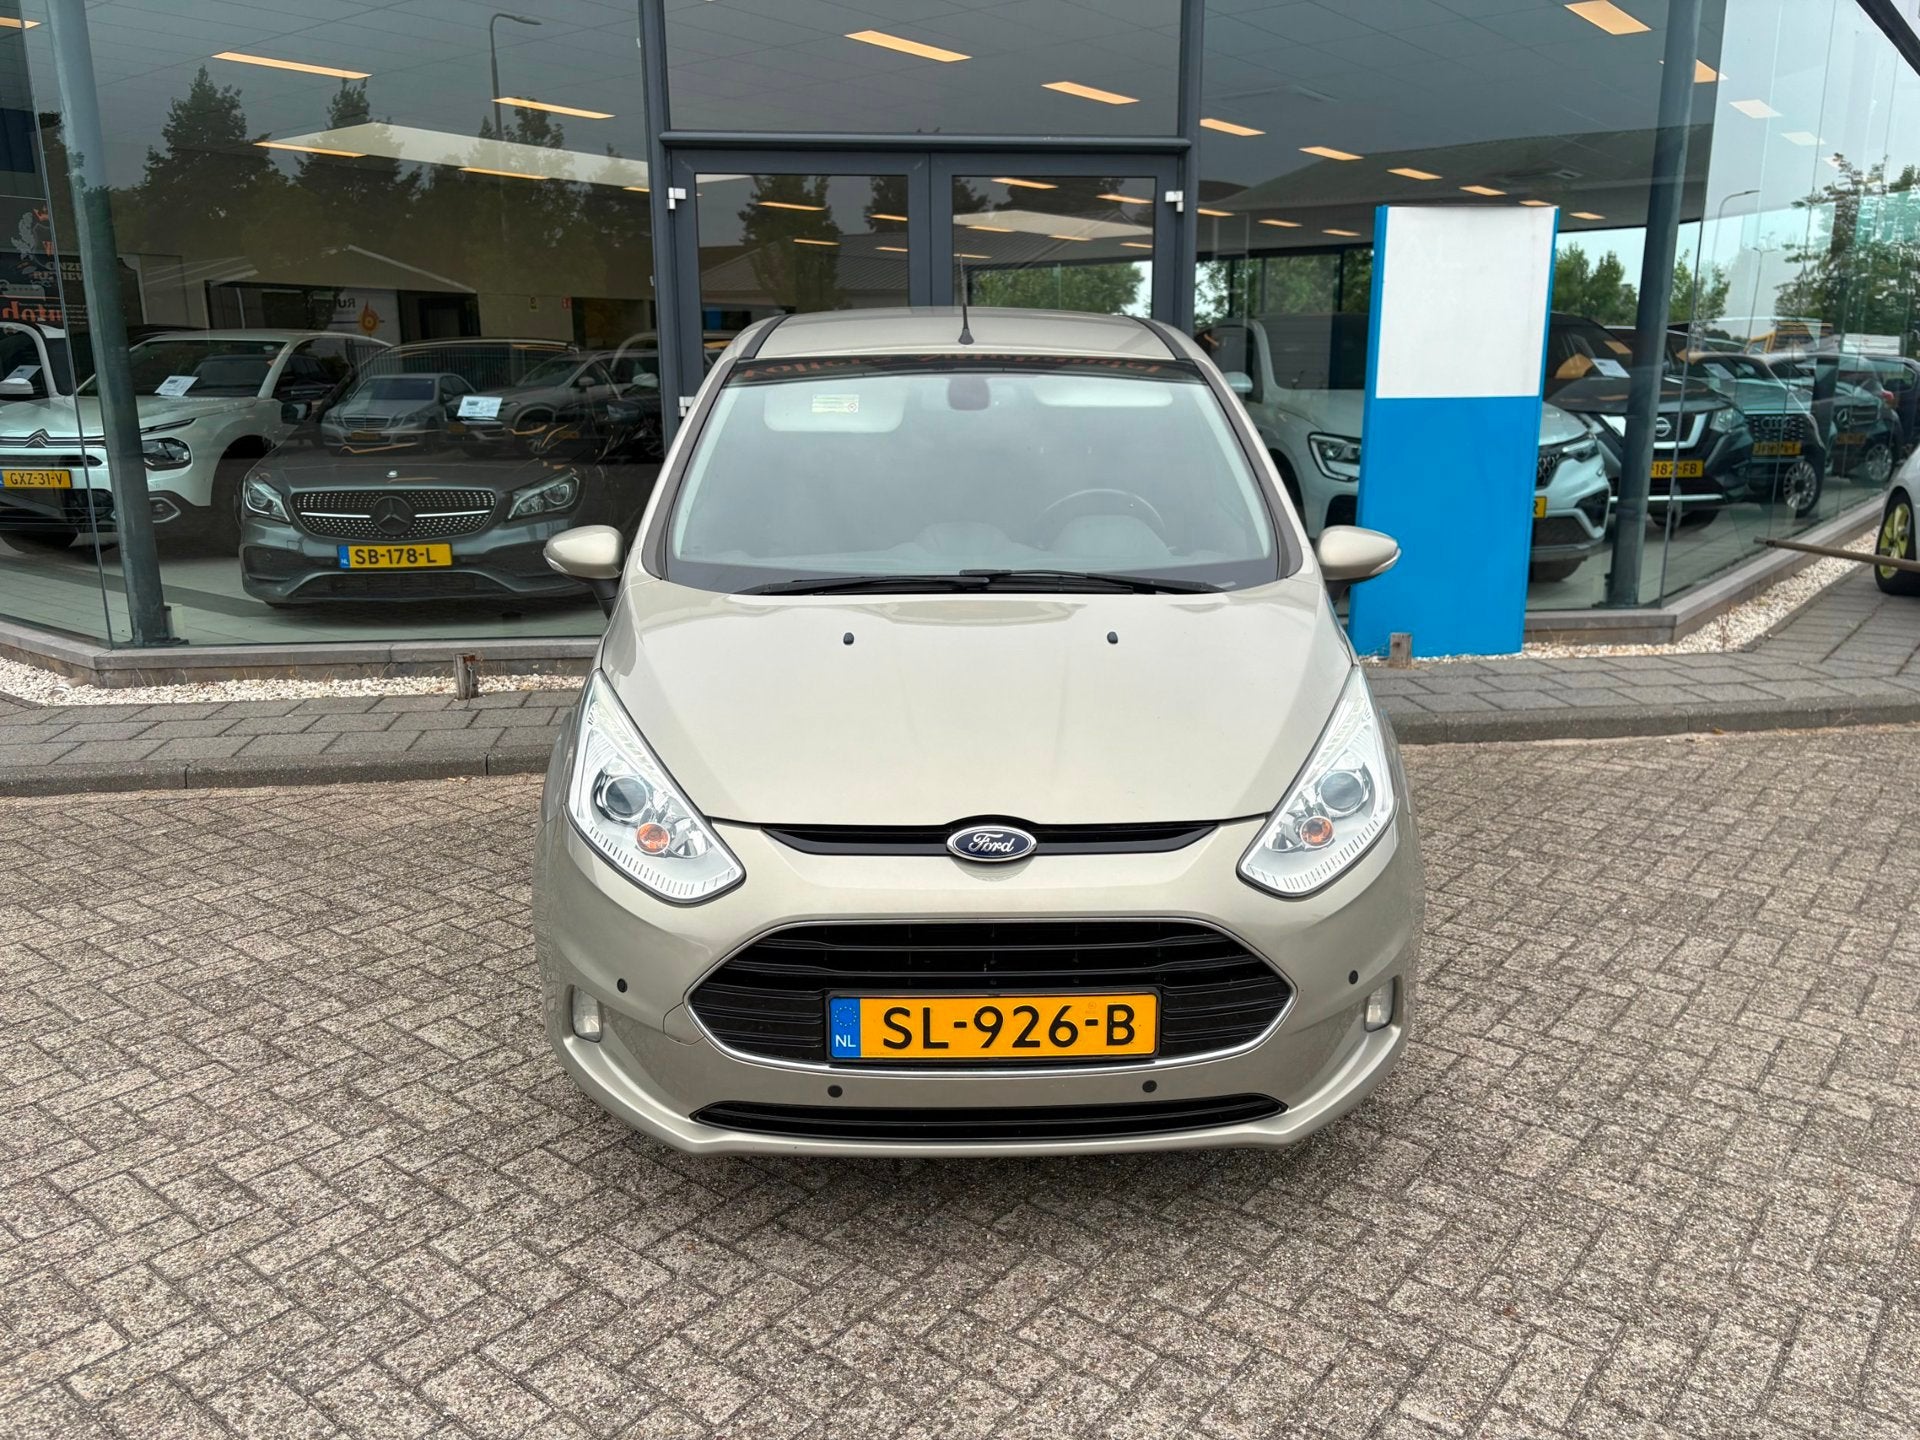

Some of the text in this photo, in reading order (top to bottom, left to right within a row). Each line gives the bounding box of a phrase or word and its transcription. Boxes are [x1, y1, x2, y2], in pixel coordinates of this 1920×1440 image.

[9, 472, 63, 486] GXZ-31-V
[354, 547, 437, 565] SB-178-L
[968, 832, 1014, 853] Ford
[835, 1004, 1136, 1050] NL SL-926-B
